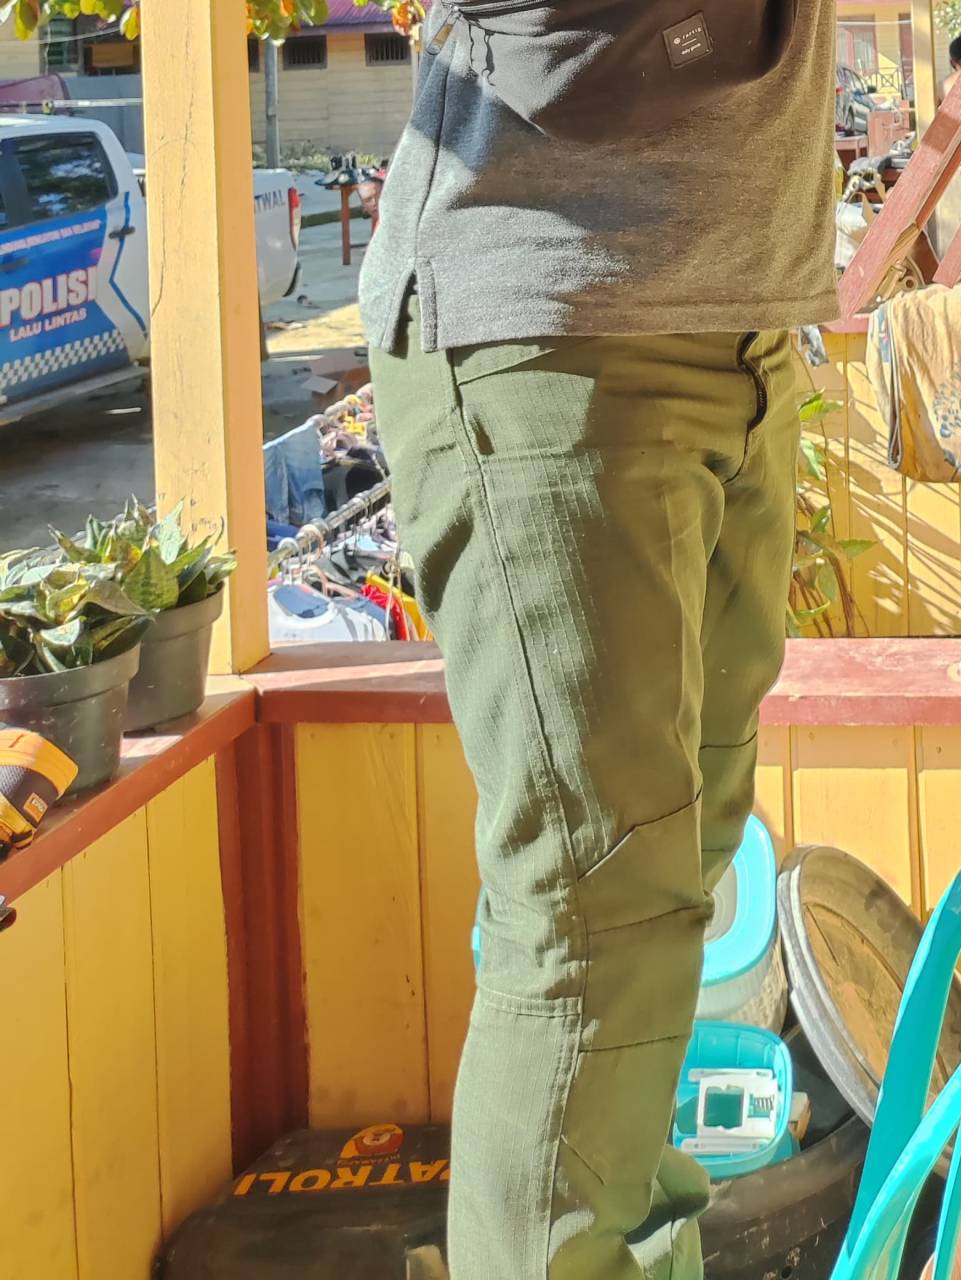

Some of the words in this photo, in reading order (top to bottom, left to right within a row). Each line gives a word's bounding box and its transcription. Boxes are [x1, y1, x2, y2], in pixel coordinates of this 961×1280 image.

[0, 266, 97, 326] POLISI
[9, 321, 42, 343] LALU
[44, 308, 87, 332] LINTAS
[234, 1159, 450, 1196] ATROLI
